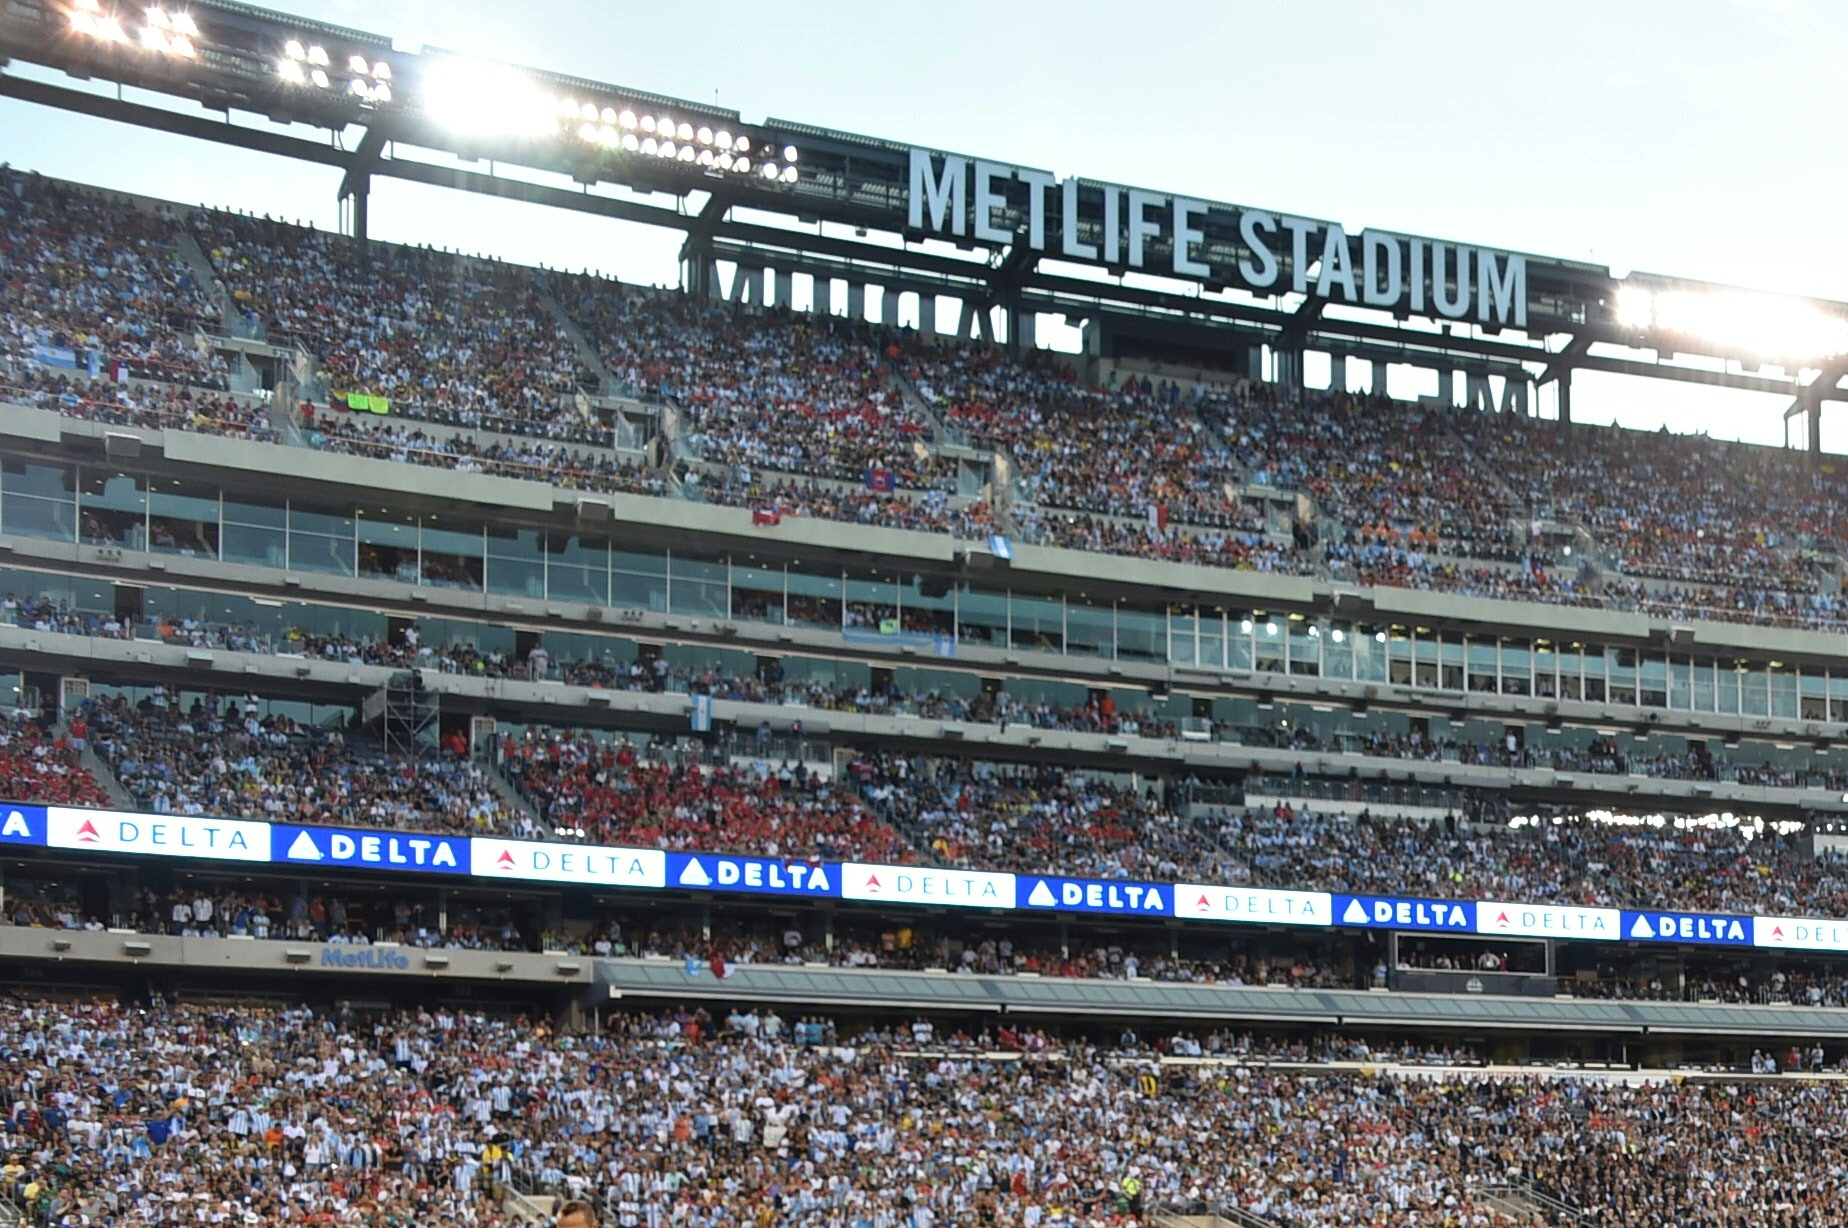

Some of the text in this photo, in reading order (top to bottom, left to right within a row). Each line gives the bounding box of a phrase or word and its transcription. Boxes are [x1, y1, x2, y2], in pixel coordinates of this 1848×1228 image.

[908, 147, 1528, 327] METLIFE STADIUM
[119, 821, 249, 850] DELTA
[331, 832, 457, 867] DELTA
[532, 850, 645, 877] DELTA
[718, 858, 830, 891] DELTA
[896, 874, 998, 898] DELTA
[1062, 882, 1164, 910] DELTA
[1224, 894, 1315, 916] DELTA
[1374, 898, 1467, 927] DELTA
[1521, 909, 1605, 932] DELTA
[1656, 915, 1745, 940] DELTA
[321, 946, 409, 969] MetLife
